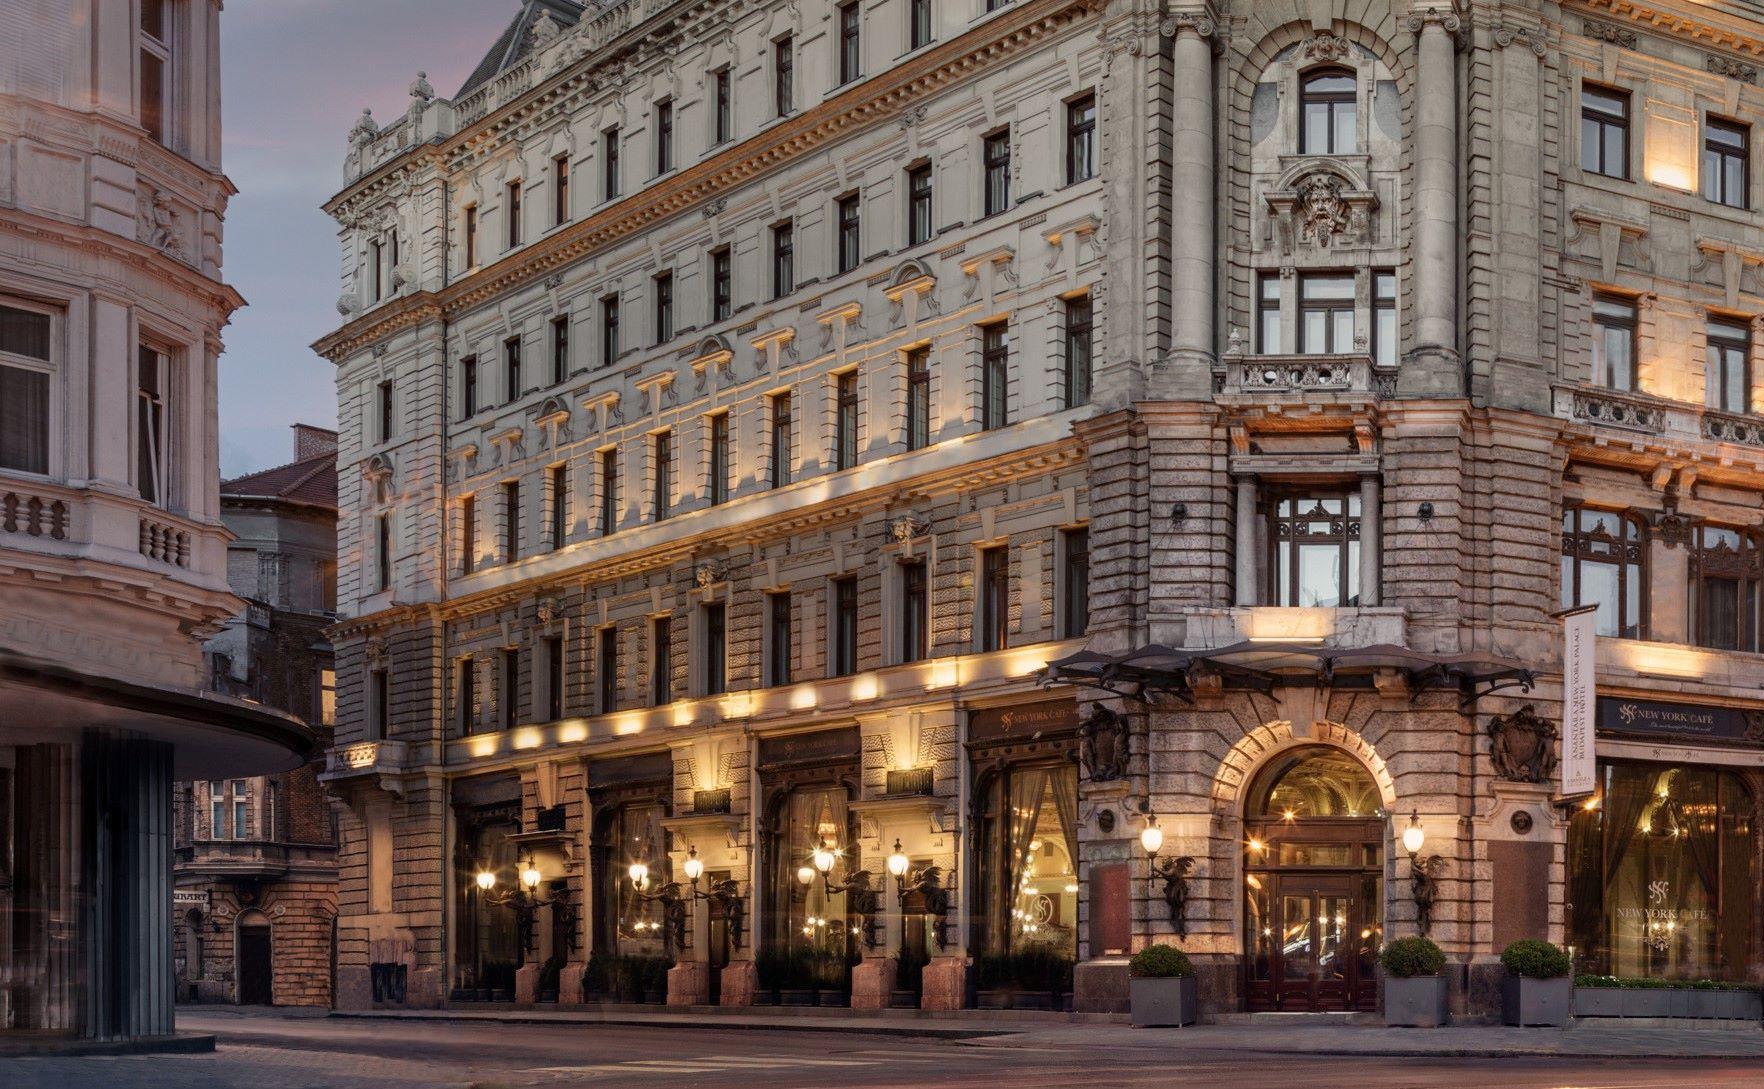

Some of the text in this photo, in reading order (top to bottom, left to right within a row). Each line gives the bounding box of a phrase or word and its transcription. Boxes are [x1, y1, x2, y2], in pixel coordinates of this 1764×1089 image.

[1572, 686, 1580, 708] NEW
[1638, 710, 1713, 724] NEW YORK CAFÉ
[1578, 715, 1586, 760] BUDAPEST
[1617, 908, 1707, 919] NEW YORK AFÉ
